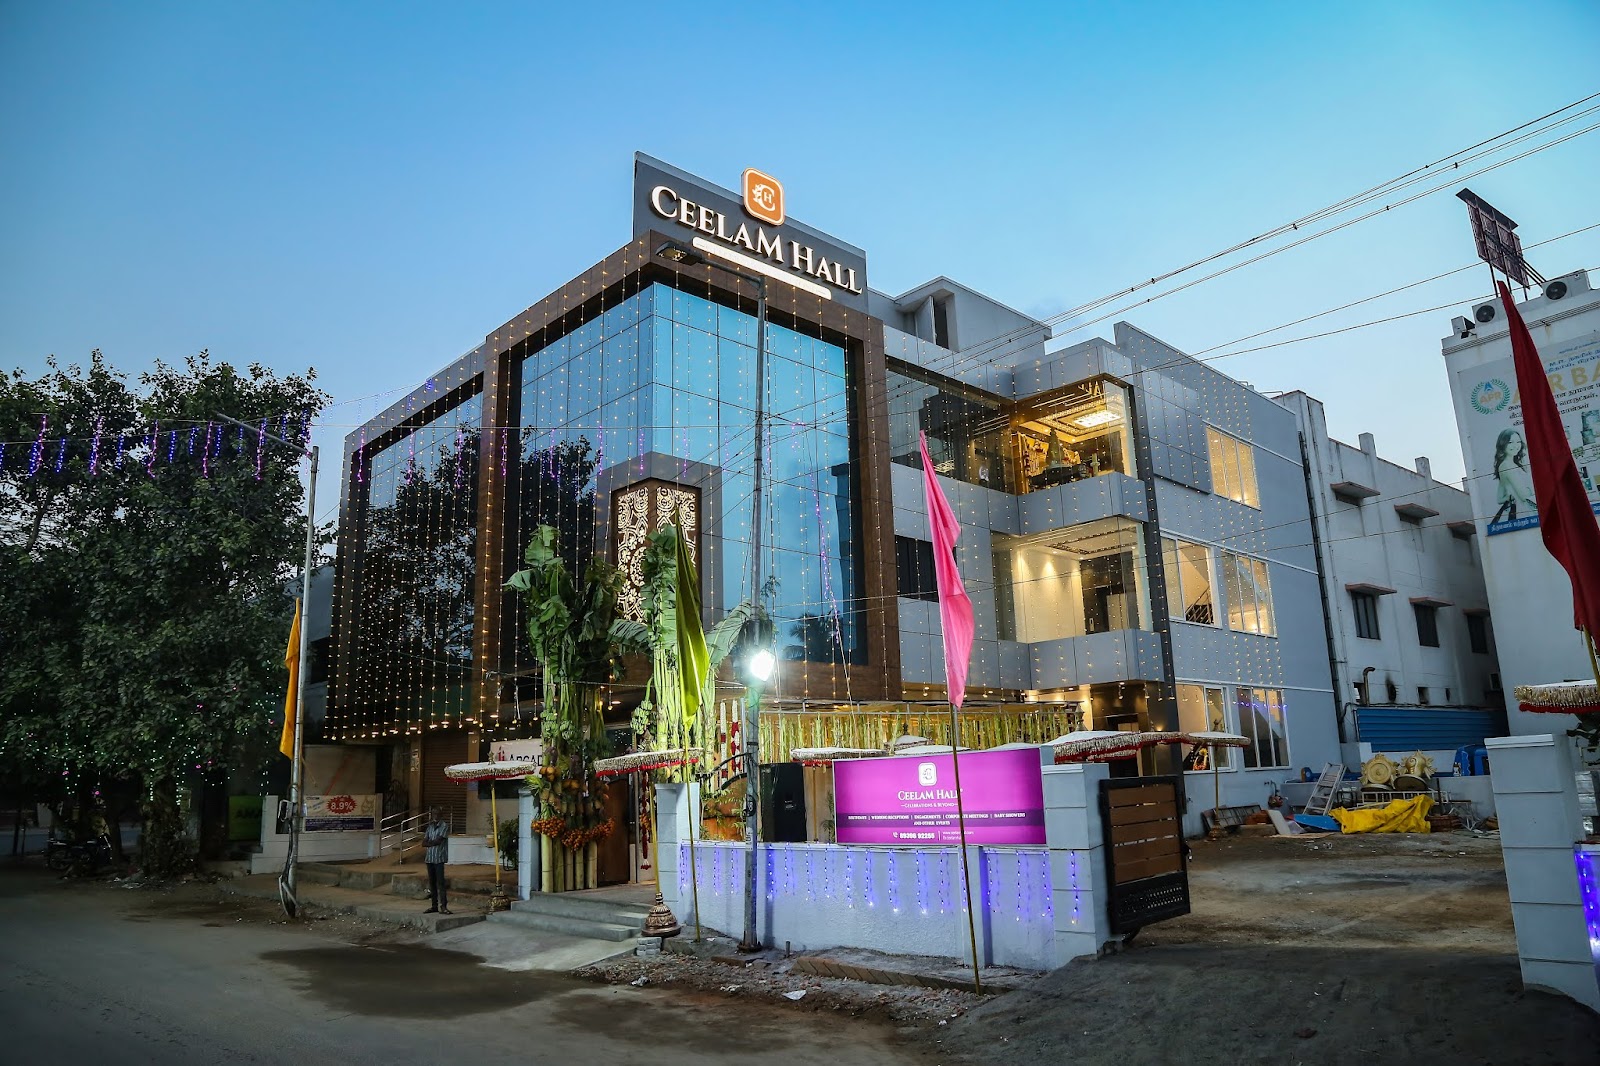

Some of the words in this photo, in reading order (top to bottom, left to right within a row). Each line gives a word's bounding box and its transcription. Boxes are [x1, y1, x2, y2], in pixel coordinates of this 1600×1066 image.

[651, 185, 784, 263] CEELAM
[791, 240, 863, 294] HALL
[897, 790, 935, 801] CEELAM
[330, 801, 353, 810] 8.9%
